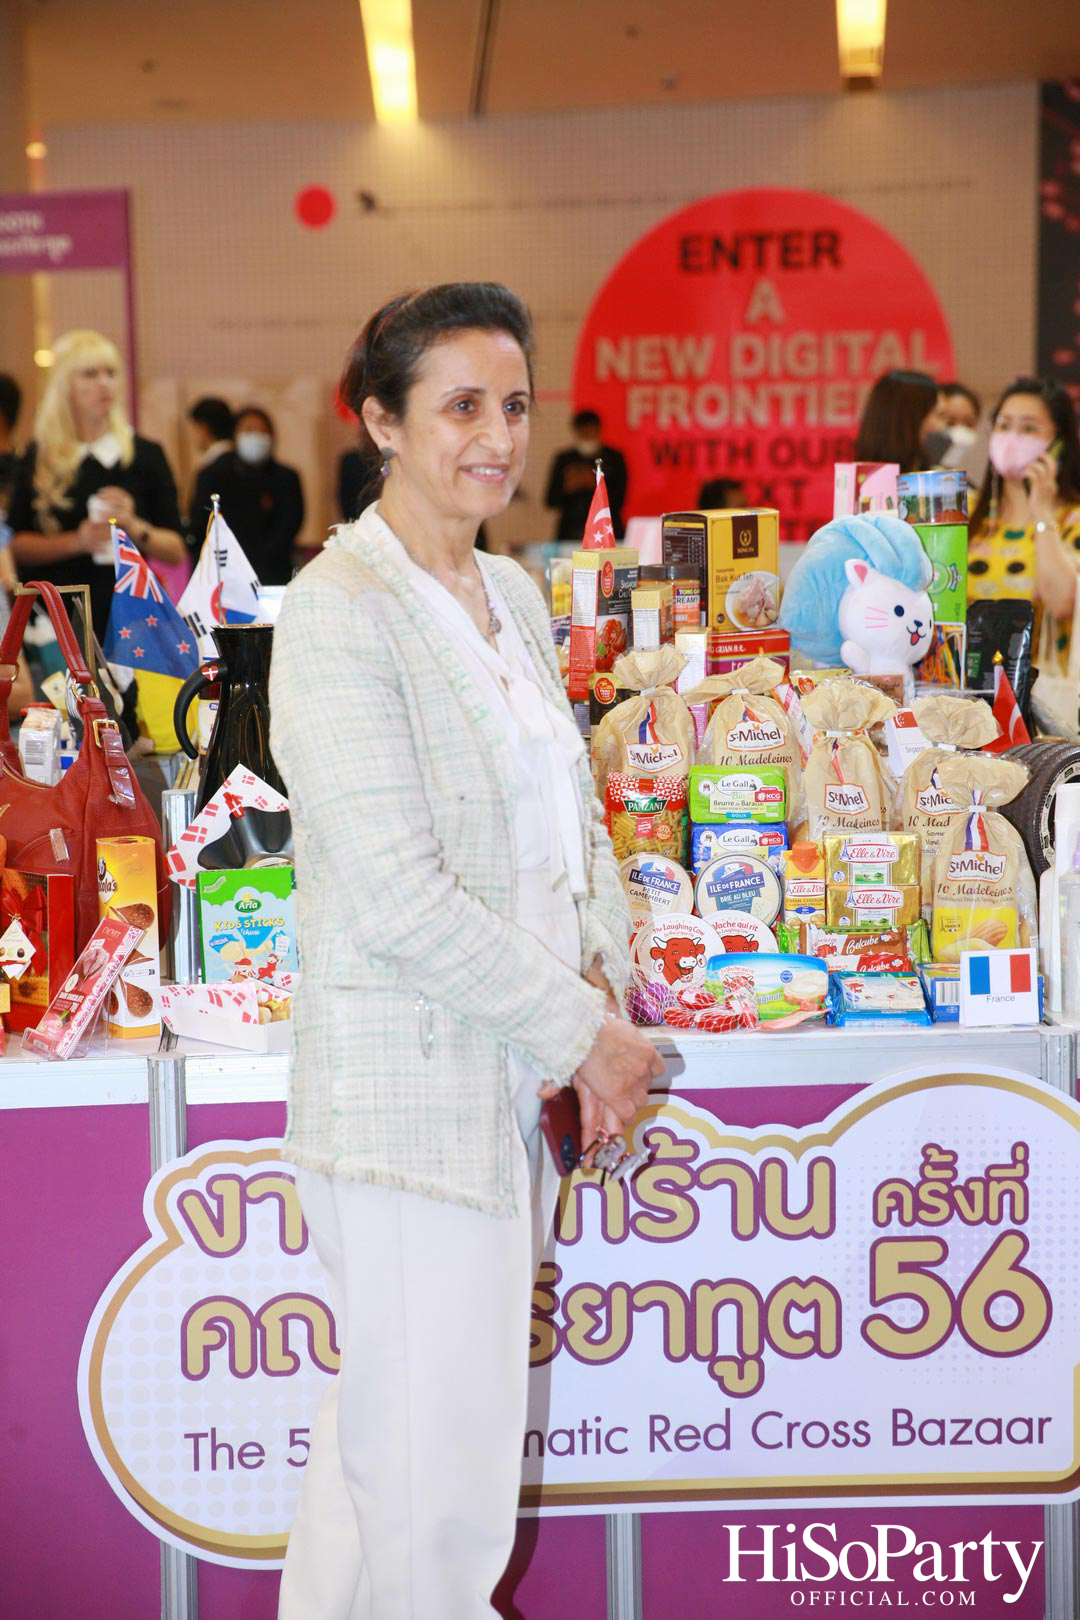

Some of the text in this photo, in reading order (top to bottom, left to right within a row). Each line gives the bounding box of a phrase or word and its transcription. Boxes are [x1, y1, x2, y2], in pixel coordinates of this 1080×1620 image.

[679, 229, 841, 273] ENTER
[745, 278, 785, 325] A
[594, 330, 942, 381] NEW DIGITAL
[651, 438, 751, 468] WITH
[716, 576, 728, 584] Bak
[736, 753, 793, 767] Madeleines
[721, 780, 749, 788] Le Gall
[723, 835, 750, 843] Le Gall
[850, 847, 870, 859] Elle
[878, 847, 896, 859] Vire
[650, 877, 680, 891] FRANCE
[710, 884, 722, 893] ILE
[730, 876, 762, 890] FRANCE
[953, 883, 1013, 898] Madeleines
[629, 889, 671, 906] CAMEMBERT
[643, 887, 662, 897] PETIT
[733, 893, 741, 901] AU
[741, 890, 756, 899] BLEU
[856, 893, 875, 905] Elle
[882, 893, 901, 904] Vire
[238, 901, 258, 910] Arla
[214, 915, 285, 931] KIDS STICKS
[663, 922, 693, 933] Laughing
[693, 926, 705, 936] Cow
[737, 921, 749, 930] qui
[749, 923, 759, 932] rit
[986, 995, 1016, 1003] France
[872, 1140, 1030, 1228] ครั้งที่
[860, 1229, 1053, 1360] 56
[184, 1427, 266, 1472] The
[649, 1407, 731, 1453] Red
[751, 1410, 872, 1450] Cross
[891, 1408, 1053, 1447] Bazaar
